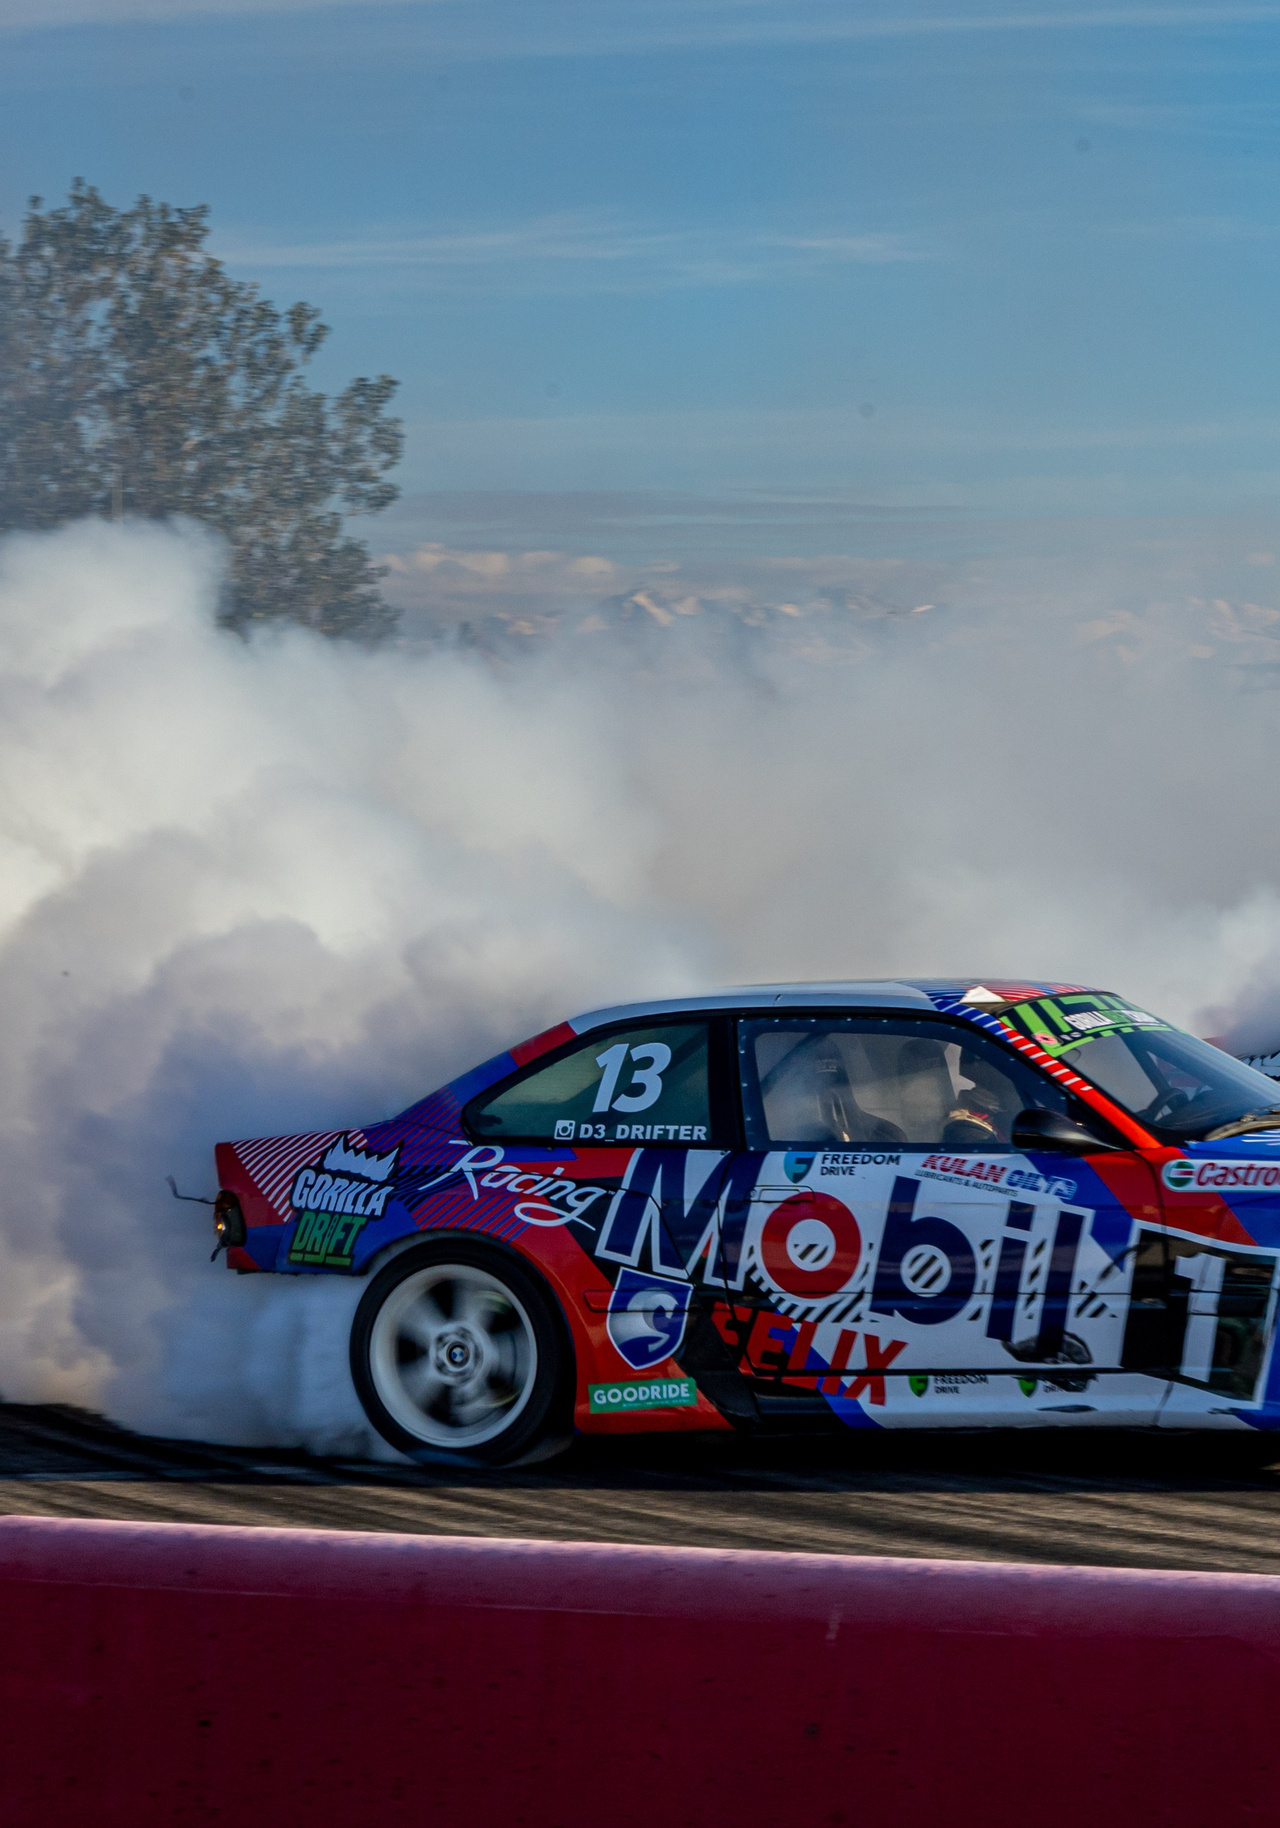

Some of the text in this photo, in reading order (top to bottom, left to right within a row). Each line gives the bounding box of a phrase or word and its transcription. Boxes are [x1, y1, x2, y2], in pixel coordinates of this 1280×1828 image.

[592, 1042, 672, 1113] 13
[579, 1124, 708, 1142] D3_DRIFTER
[820, 1166, 856, 1176] DRIVE
[821, 1154, 901, 1165] FREEDOM
[921, 1154, 1008, 1183] KULAN
[292, 1168, 395, 1217] GORILLA
[418, 1141, 600, 1231] Racing
[290, 1211, 368, 1264] DRIFT
[596, 1149, 1090, 1354] Mobil
[709, 1302, 908, 1405] FELIX
[593, 1383, 691, 1405] GOODRIDE
